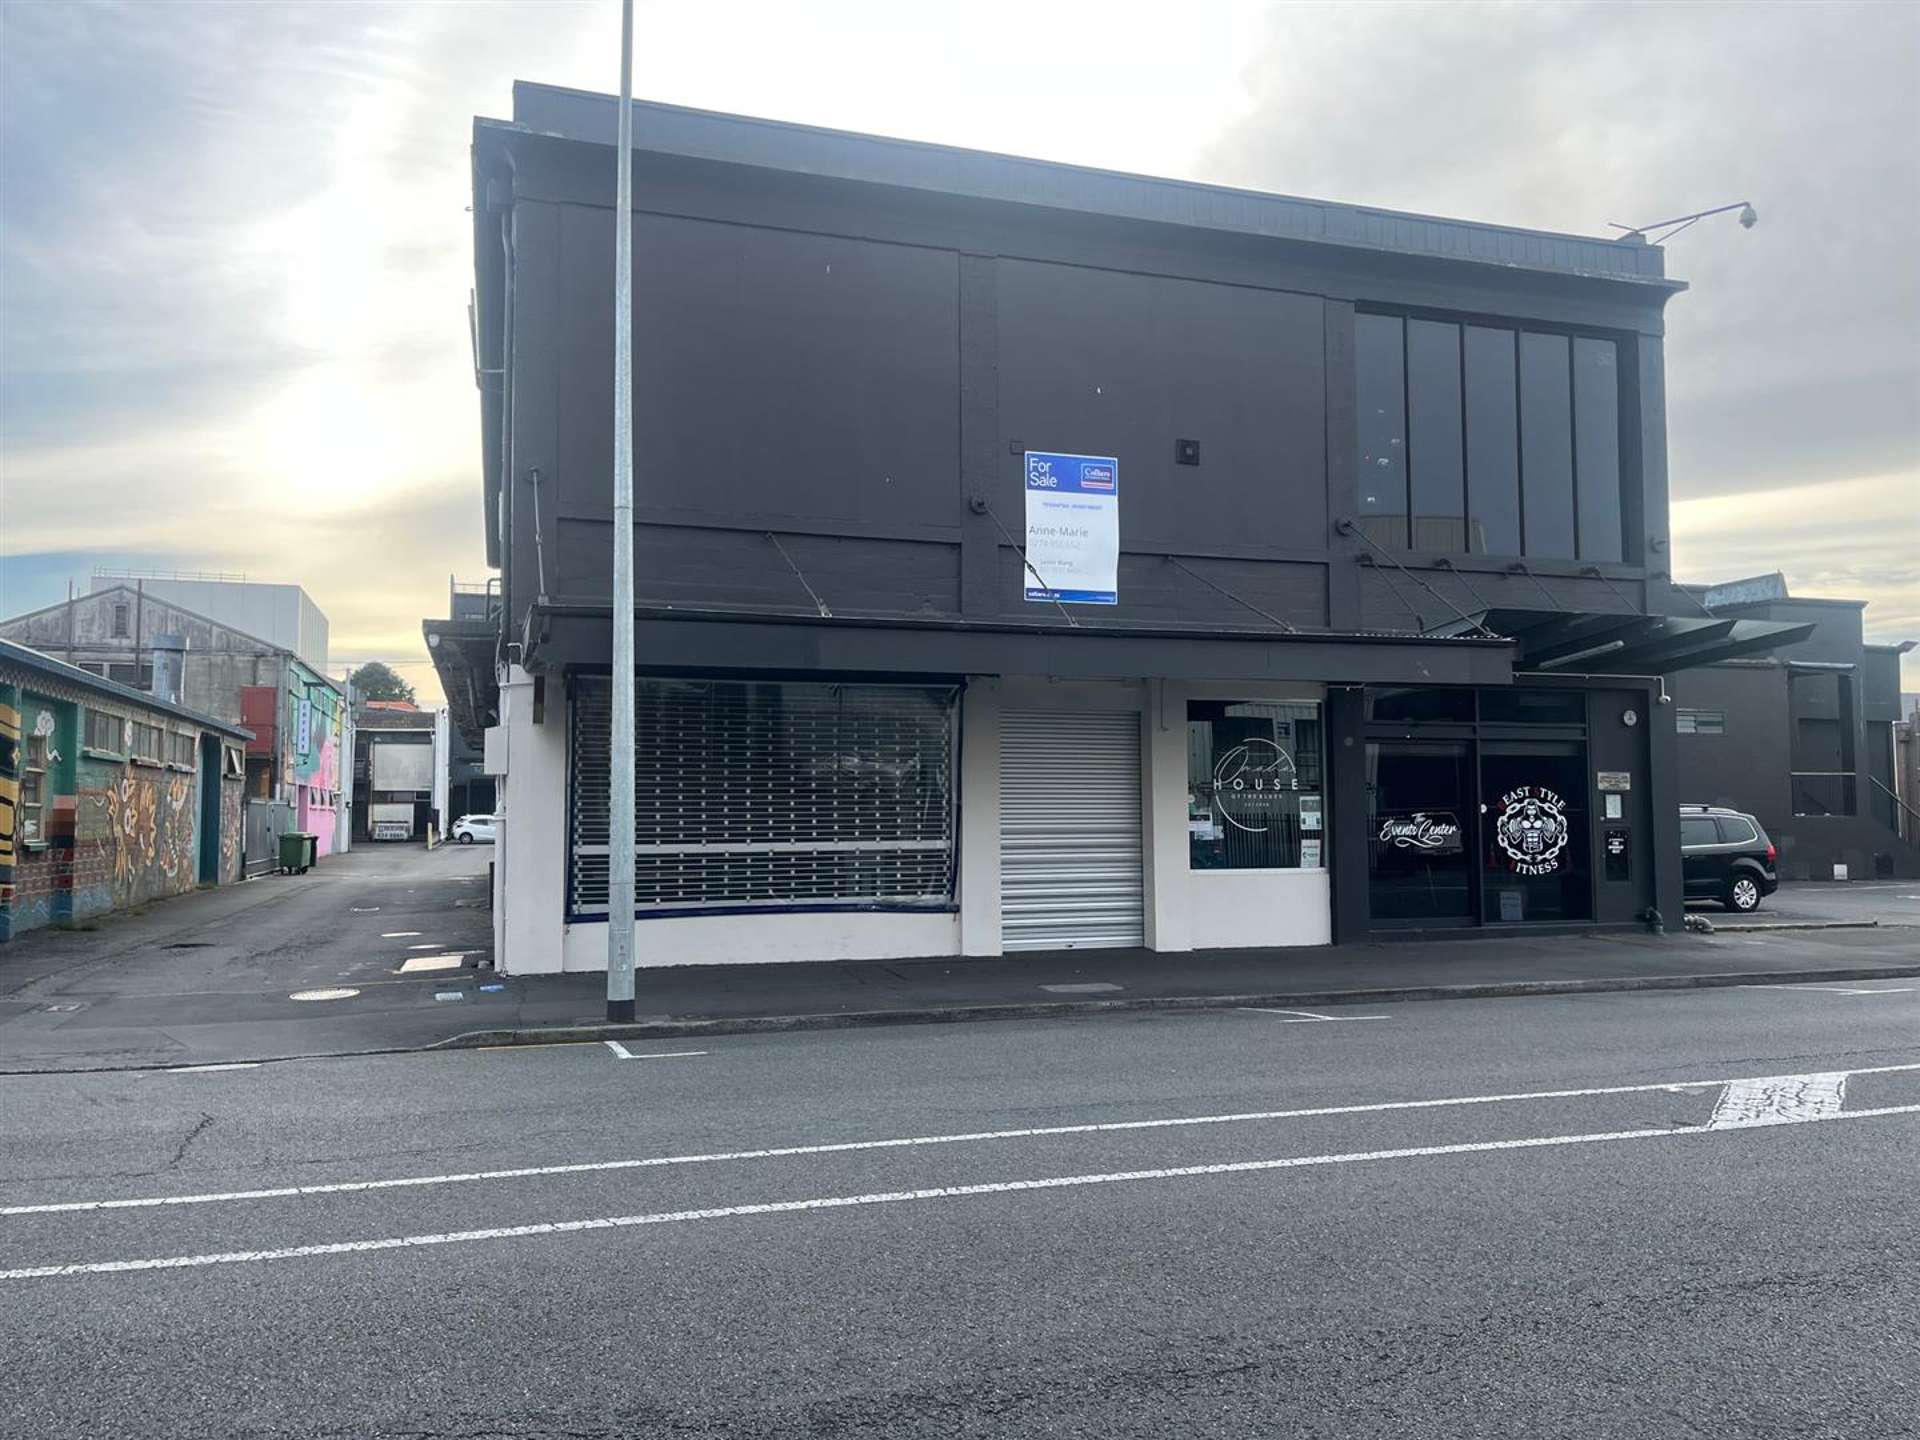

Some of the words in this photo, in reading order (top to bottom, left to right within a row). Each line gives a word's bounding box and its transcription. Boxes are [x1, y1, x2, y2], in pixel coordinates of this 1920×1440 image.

[1030, 457, 1051, 473] For
[1030, 471, 1057, 488] Sale
[1029, 525, 1089, 538] Anne-Marie
[1213, 777, 1299, 791] HOUSE
[1380, 819, 1418, 841] Events
[1418, 819, 1458, 843] Center
